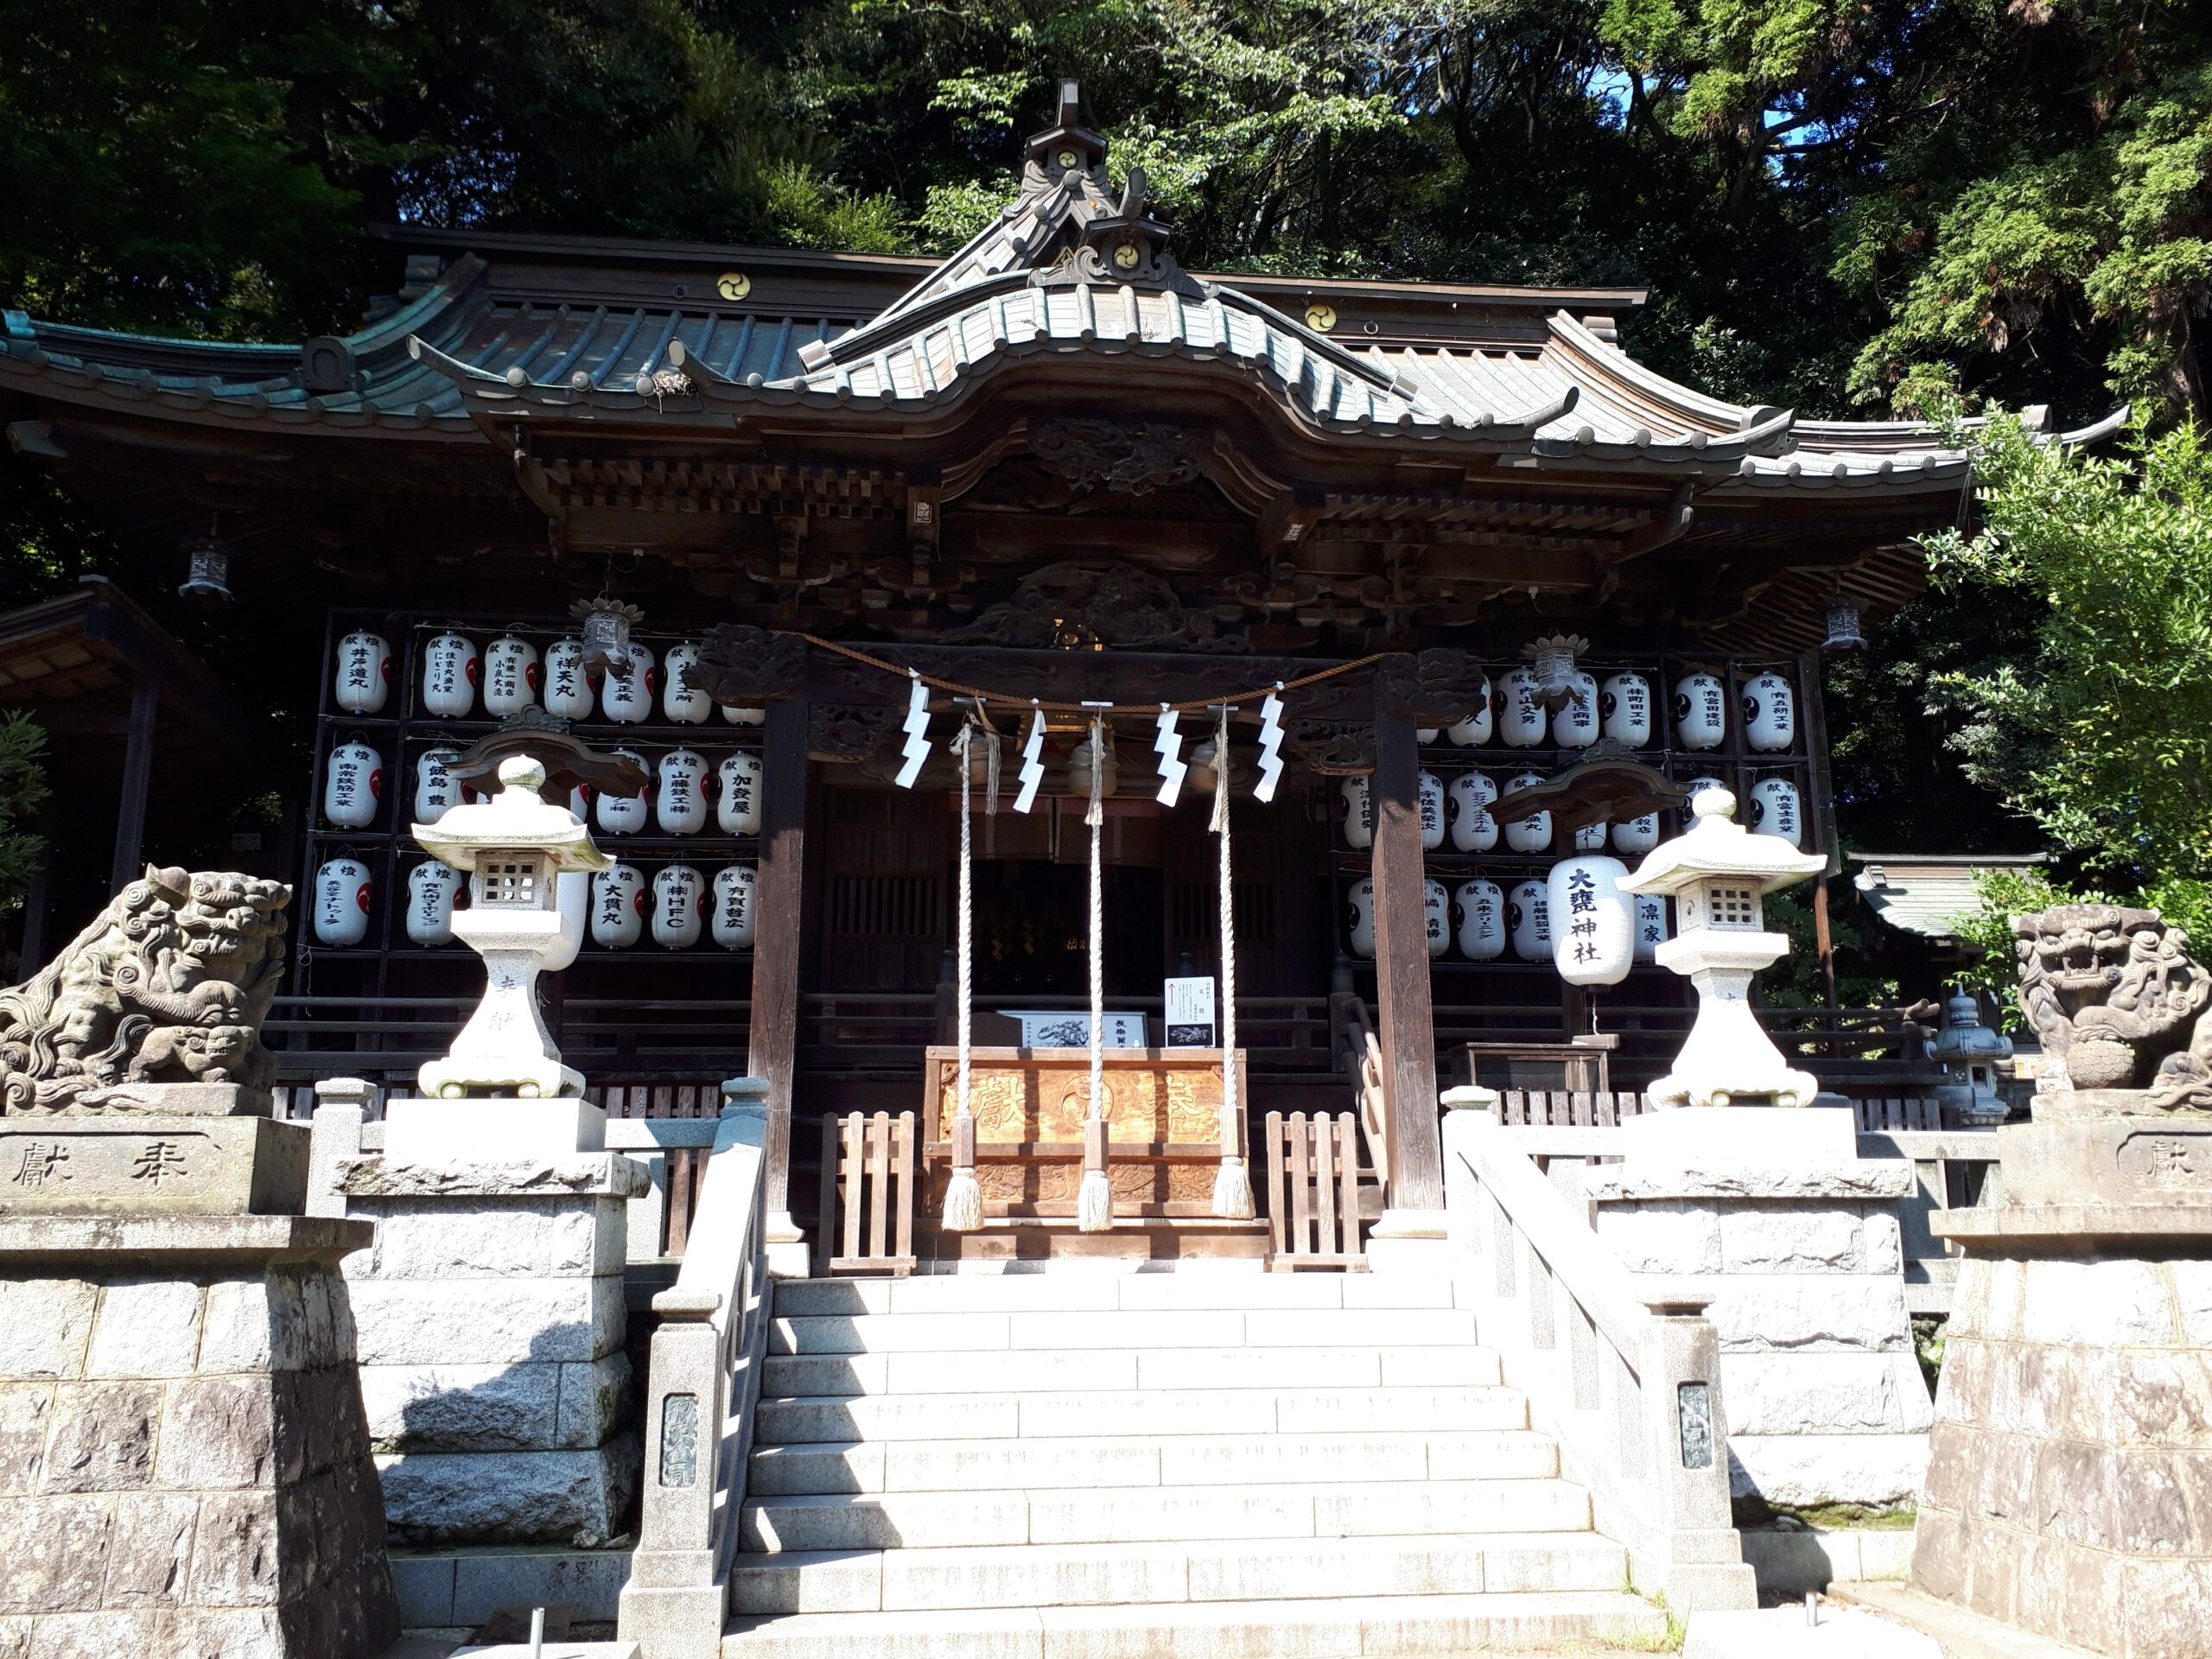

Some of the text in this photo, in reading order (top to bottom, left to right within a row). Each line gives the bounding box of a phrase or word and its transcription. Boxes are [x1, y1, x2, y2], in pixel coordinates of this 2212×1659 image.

[345, 636, 380, 647] 献燈
[429, 639, 464, 651] 献燈
[488, 644, 524, 655] 献燈
[550, 645, 583, 654] 献燈
[348, 648, 370, 688] 井戸道丸
[556, 657, 576, 697] 祥天丸
[333, 749, 370, 761] 献燈
[665, 756, 698, 767] 献燈
[724, 760, 762, 772] 献燈
[427, 766, 449, 807] 飯島豊
[1461, 779, 1494, 789] 献燈
[731, 773, 753, 815] 加登屋
[319, 866, 357, 877] 献燈
[415, 868, 452, 880] 献燈
[597, 871, 633, 882] 献燈
[660, 872, 695, 883] 献燈
[721, 873, 755, 883] 献燈
[1465, 886, 1499, 896] 献燈
[601, 884, 624, 925] 大貫丸
[724, 887, 747, 929] 有賀哲広
[1567, 868, 1602, 964] 大甕神社
